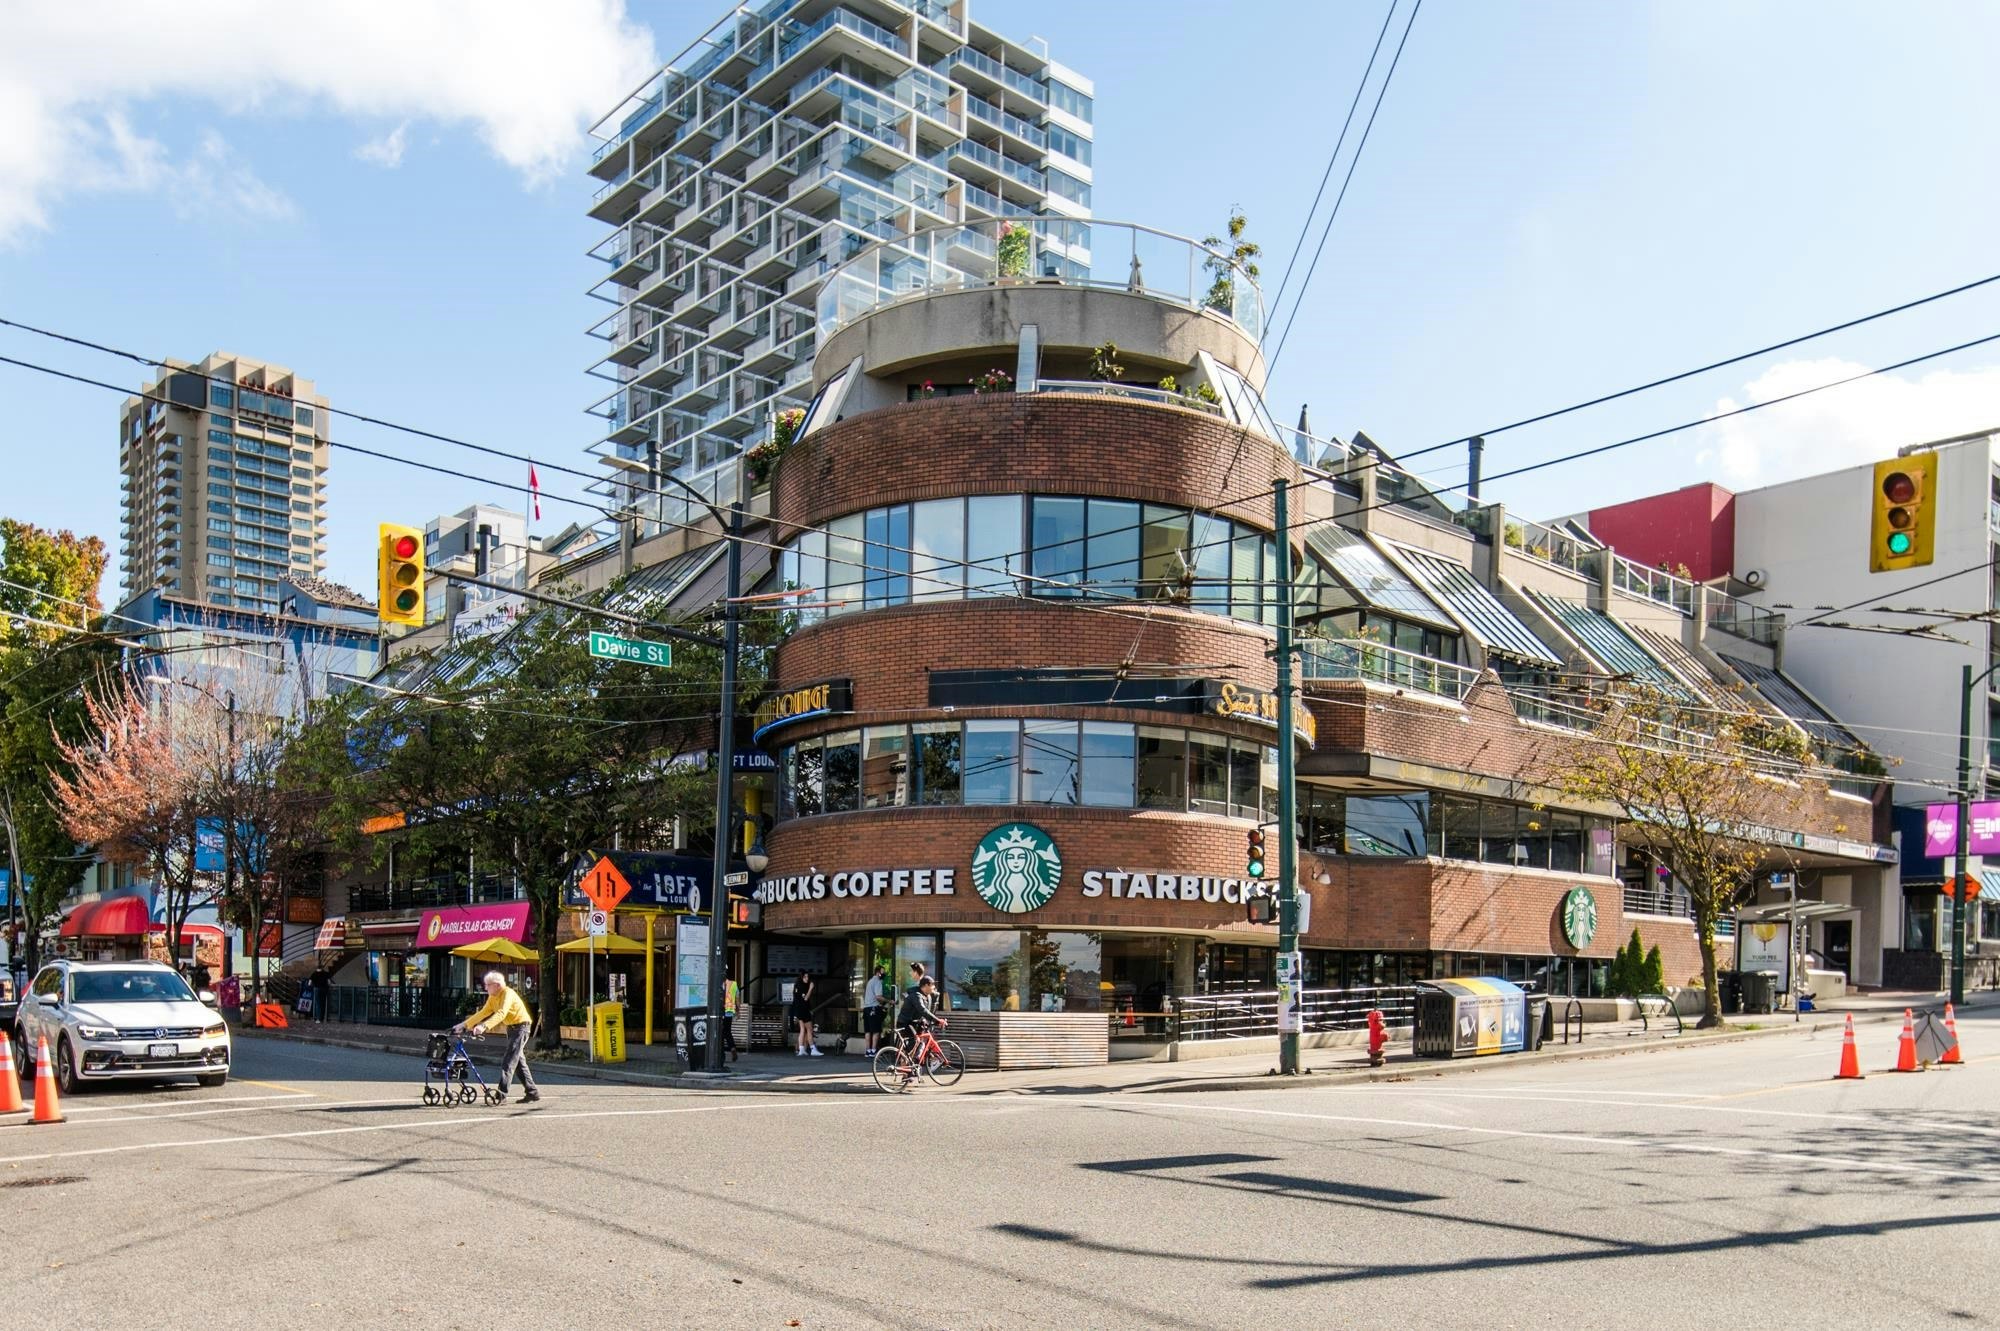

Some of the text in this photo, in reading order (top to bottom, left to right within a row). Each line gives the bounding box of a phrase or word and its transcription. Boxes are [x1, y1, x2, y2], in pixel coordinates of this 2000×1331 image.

[598, 637, 663, 662] Davie St
[654, 873, 697, 902] LOFT
[832, 868, 955, 898] COFFEE
[1082, 871, 1267, 904] STARBUCKS
[440, 918, 516, 934] MARBLE SLAB CREAMERY
[609, 1028, 618, 1057] FREE
